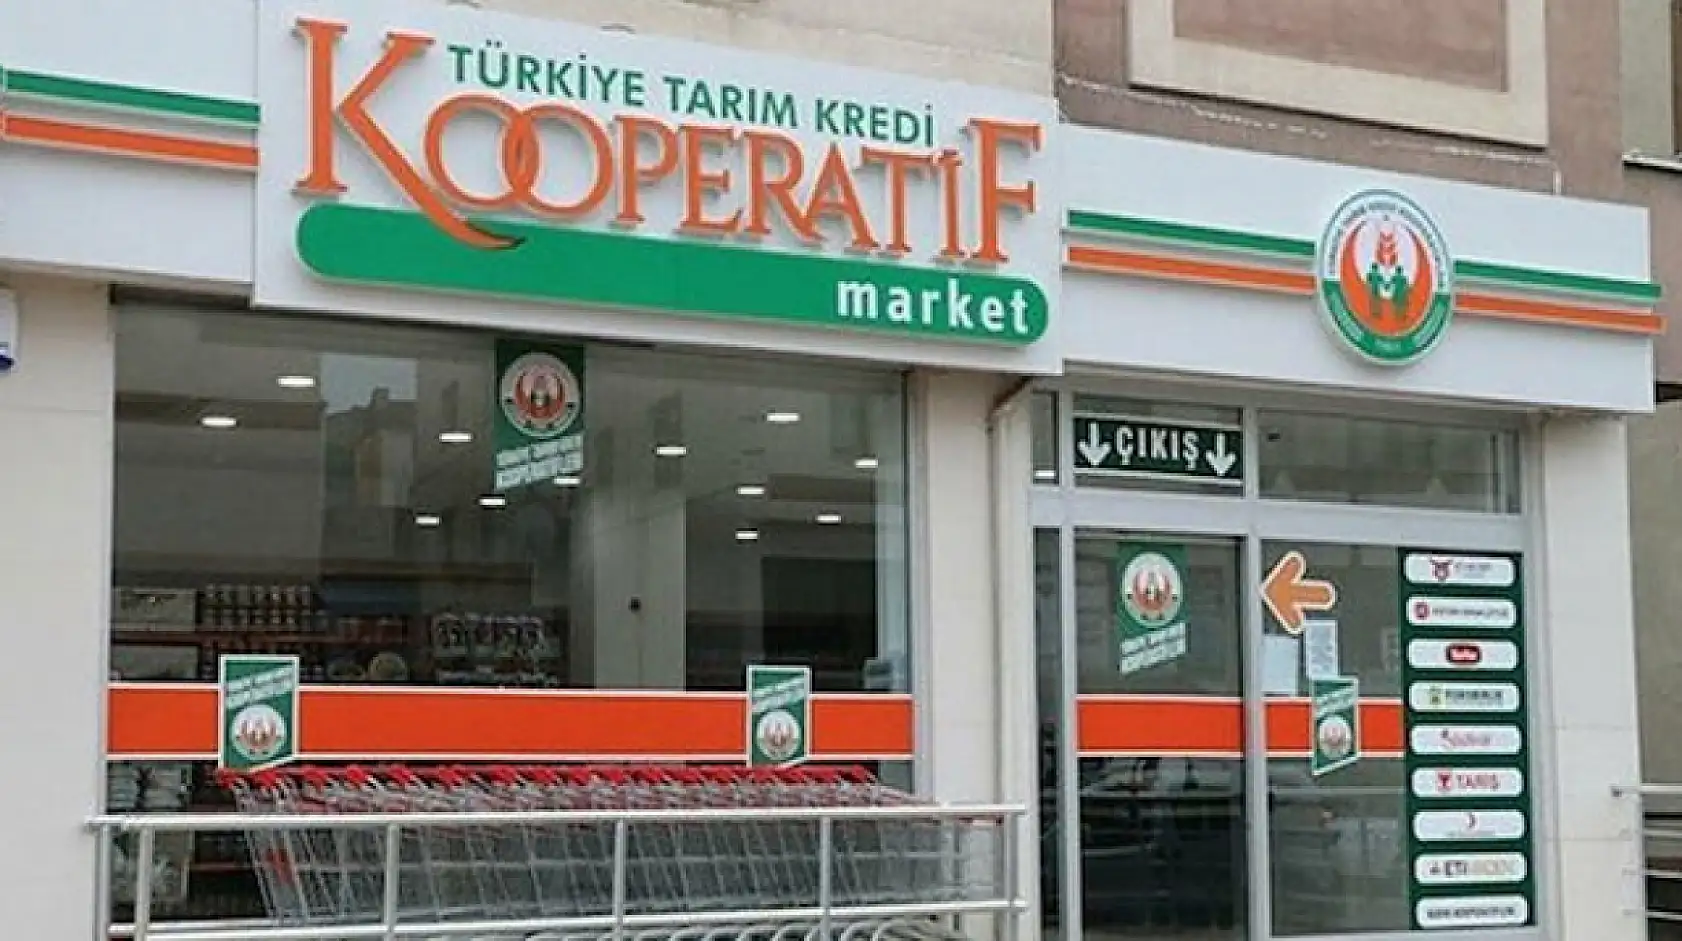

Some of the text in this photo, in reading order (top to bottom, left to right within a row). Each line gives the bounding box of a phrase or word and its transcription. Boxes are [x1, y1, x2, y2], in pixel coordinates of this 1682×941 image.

[447, 39, 935, 147] TÜRKİYE TARIM KREDİ
[294, 18, 1042, 264] KOOPERATİF
[837, 278, 1029, 335] market
[1116, 425, 1200, 471] ÇIKIŞ
